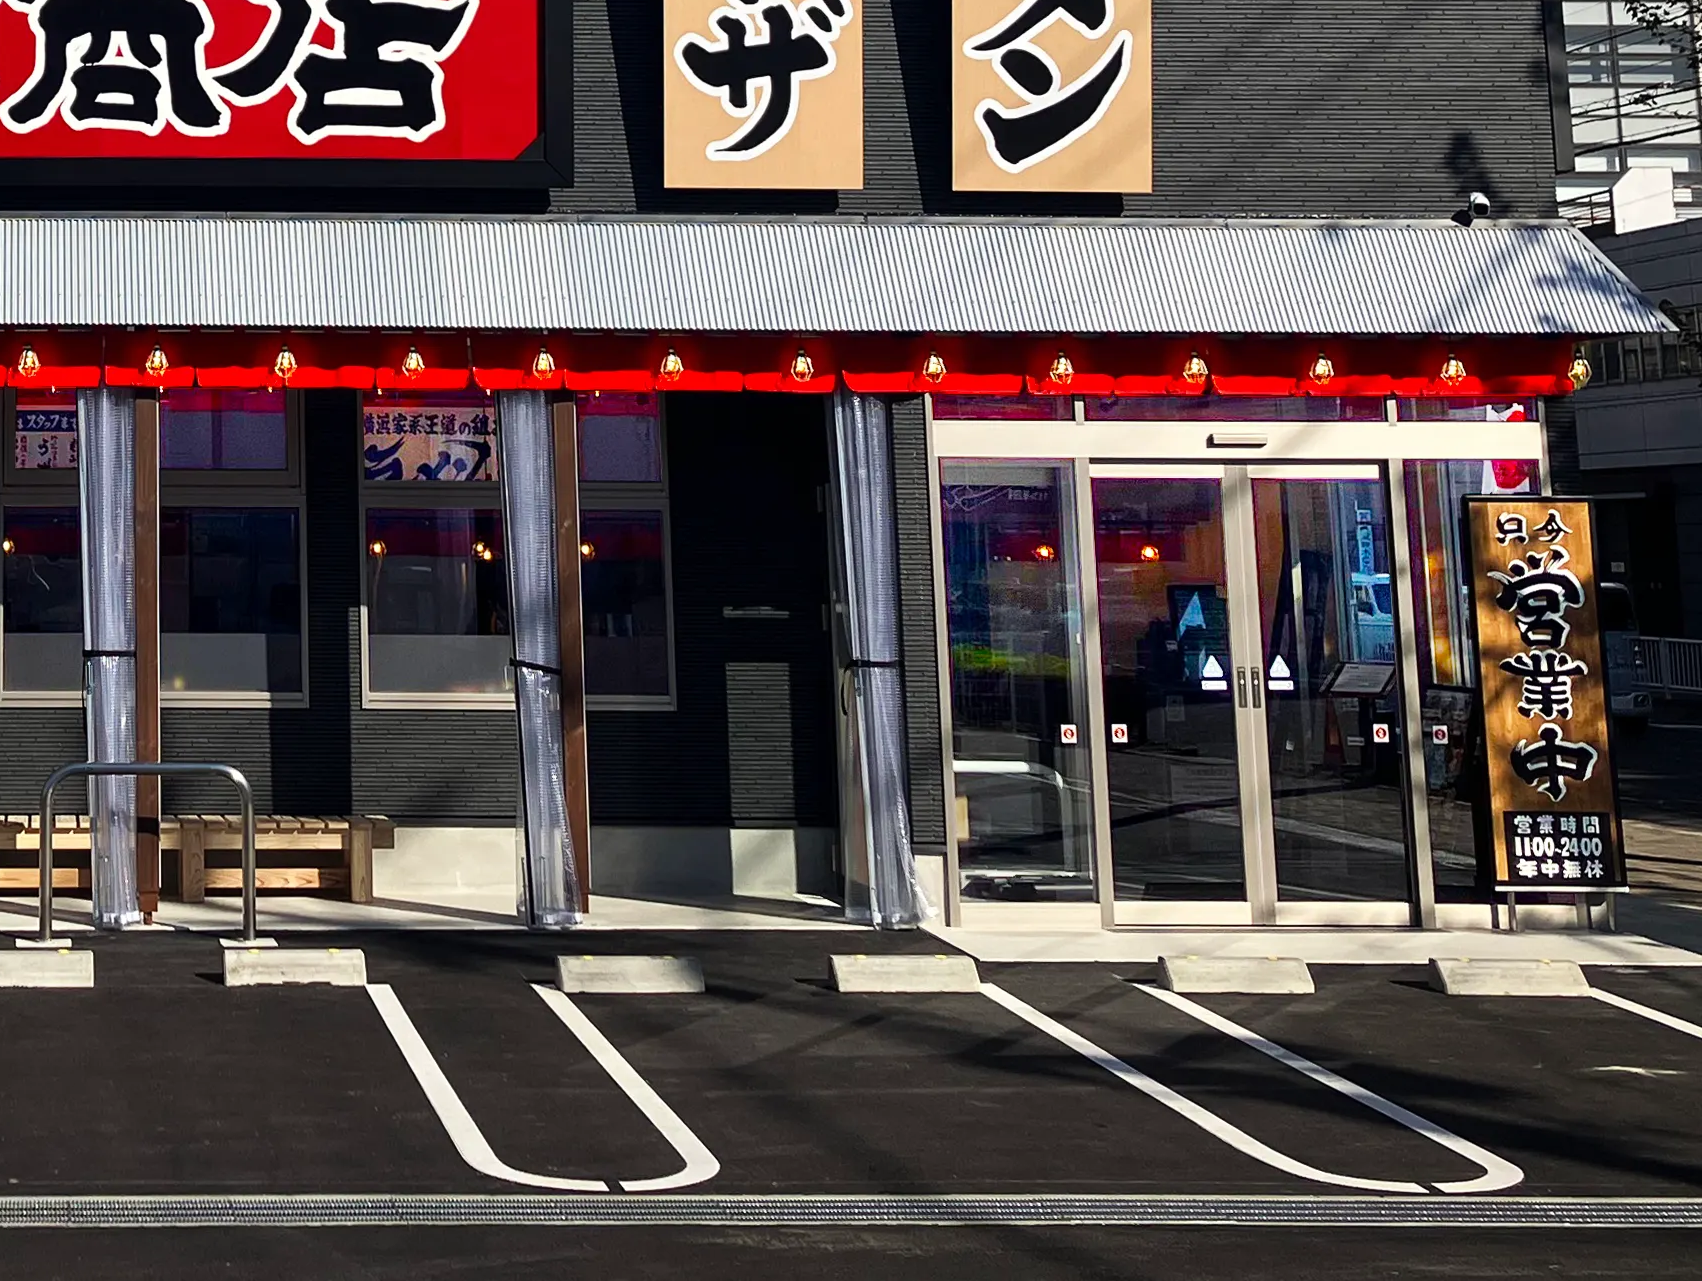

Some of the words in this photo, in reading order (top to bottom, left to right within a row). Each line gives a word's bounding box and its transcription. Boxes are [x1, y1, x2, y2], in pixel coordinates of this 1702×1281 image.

[1495, 509, 1574, 547] 只今
[1486, 543, 1596, 803] 営業中
[1513, 814, 1600, 835] 営業時間
[1516, 858, 1604, 879] 年中無休
